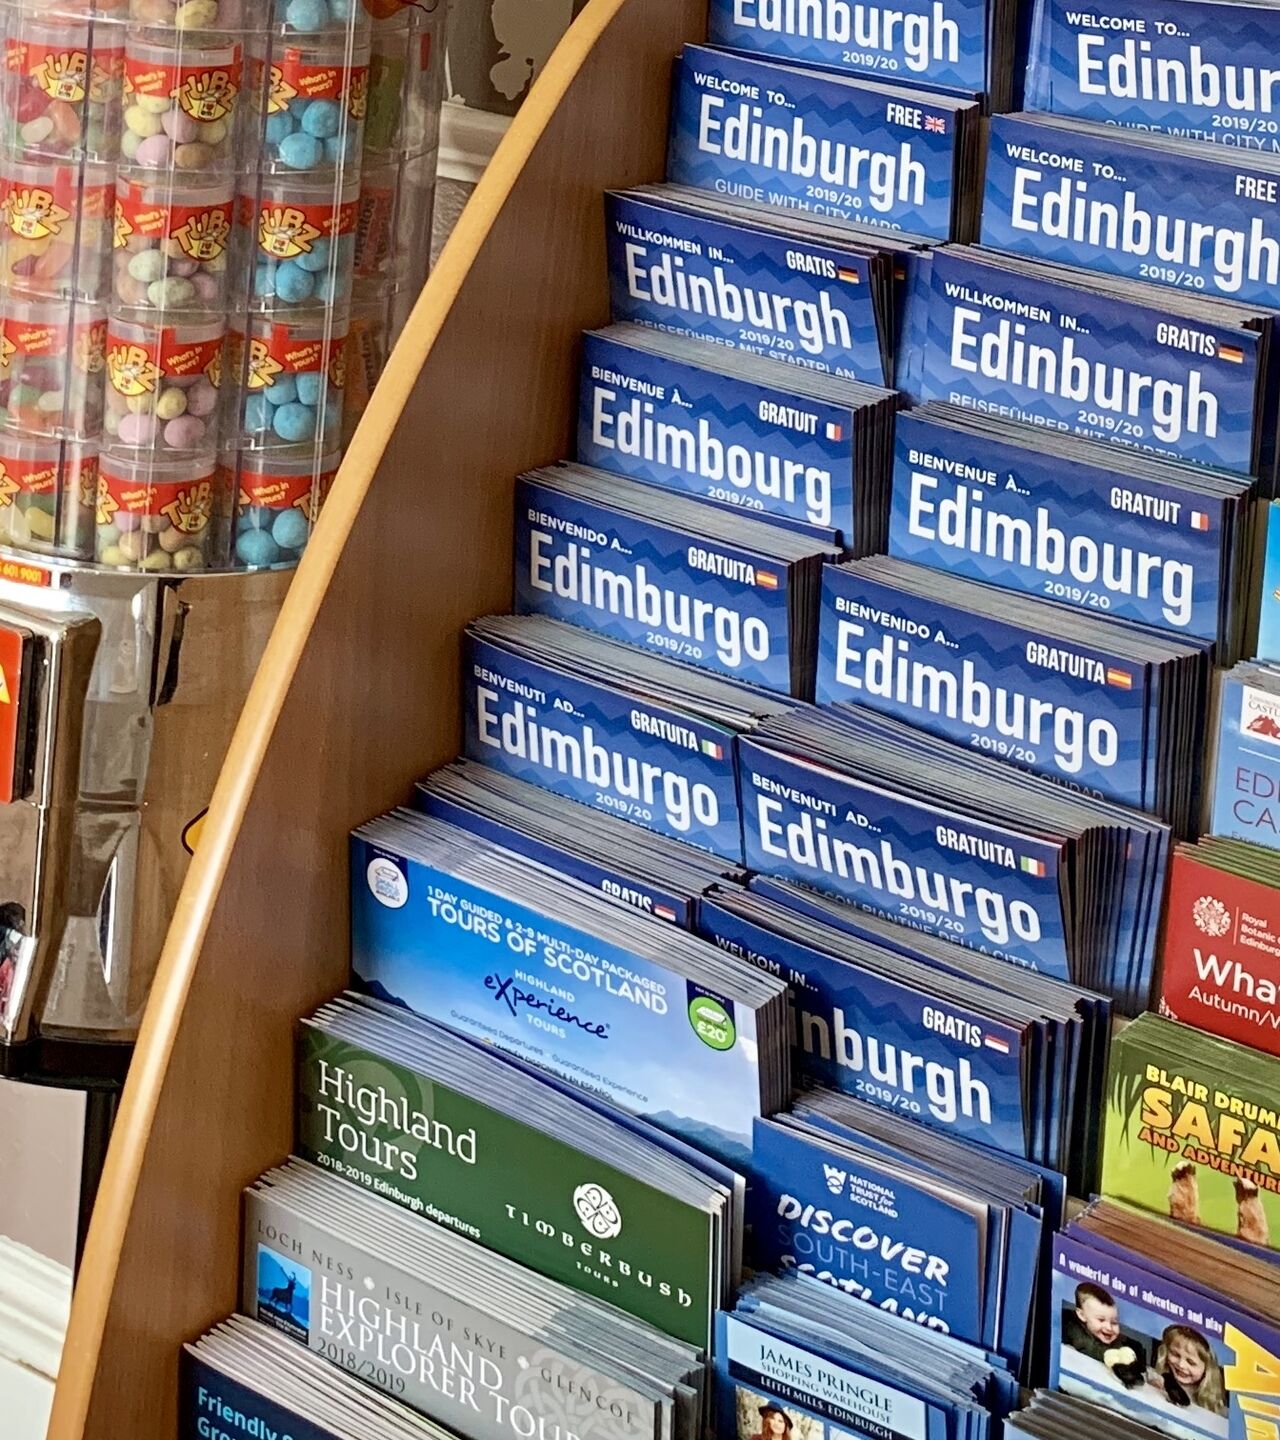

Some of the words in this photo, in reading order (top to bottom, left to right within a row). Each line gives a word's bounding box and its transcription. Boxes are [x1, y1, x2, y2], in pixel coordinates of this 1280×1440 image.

[843, 51, 898, 71] 2019/20
[786, 250, 837, 280] GRATIS
[759, 400, 818, 435] GRATUIT
[592, 386, 832, 527] Edimbourg
[3, 564, 18, 578] 601
[20, 567, 42, 583] 9001
[688, 547, 756, 586] GRATUITA
[909, 471, 1194, 627] Edimbourg
[530, 529, 770, 667] Edimburgo
[835, 619, 1119, 773] Edimburgo
[427, 896, 500, 943] TOURS
[507, 933, 537, 958] OF
[544, 946, 668, 1016] SCOTLAND
[1241, 925, 1276, 944] Botanic
[514, 969, 575, 1004] HIGHLAND
[526, 1014, 566, 1039] TOURS
[318, 1060, 477, 1165] Highland
[1146, 1064, 1208, 1102] BLAIR
[318, 1104, 418, 1181] Tours
[1139, 1129, 1178, 1153] AND
[317, 1152, 372, 1187] 2018-2019
[374, 1177, 424, 1211] Edinburgh
[425, 1202, 482, 1238] departures
[777, 1193, 950, 1288] DISCOVER
[777, 1224, 949, 1311] SOUTH-EAST
[258, 1220, 303, 1255] LOCH
[312, 1250, 354, 1281] NESS
[386, 1287, 422, 1315] ISLE
[432, 1312, 453, 1332] OF
[464, 1327, 506, 1360] SKYE
[541, 1367, 634, 1425] GLENCOE
[321, 1276, 503, 1392] HIGHLAND
[321, 1306, 481, 1412] EXPLORER
[317, 1337, 406, 1394] 2018/2019
[759, 1344, 812, 1382] JAMES
[818, 1366, 893, 1413] PRINGLE
